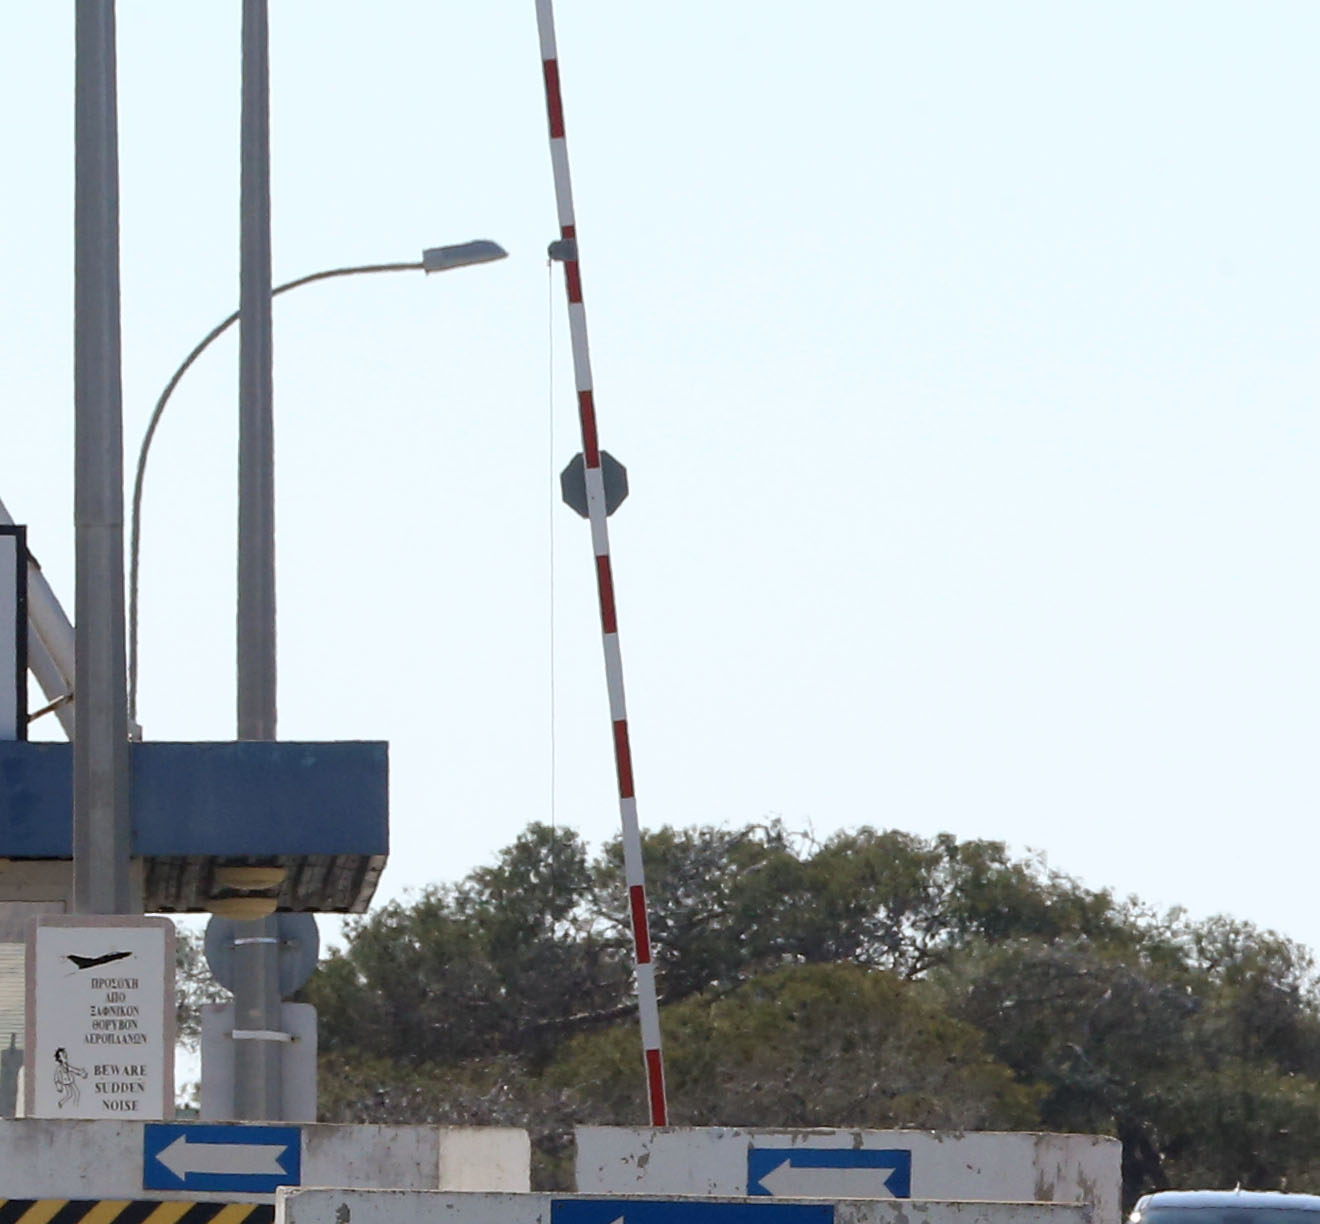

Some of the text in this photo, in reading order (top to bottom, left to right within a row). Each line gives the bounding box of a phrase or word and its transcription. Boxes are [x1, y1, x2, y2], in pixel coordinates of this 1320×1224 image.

[91, 978, 139, 990] ΠΡΟΣΟΧΗ
[105, 993, 126, 1003] ΑΠΟ
[94, 1064, 147, 1076] BEWARE
[95, 1082, 145, 1094] SUDDEN
[102, 1099, 139, 1111] NOISE
